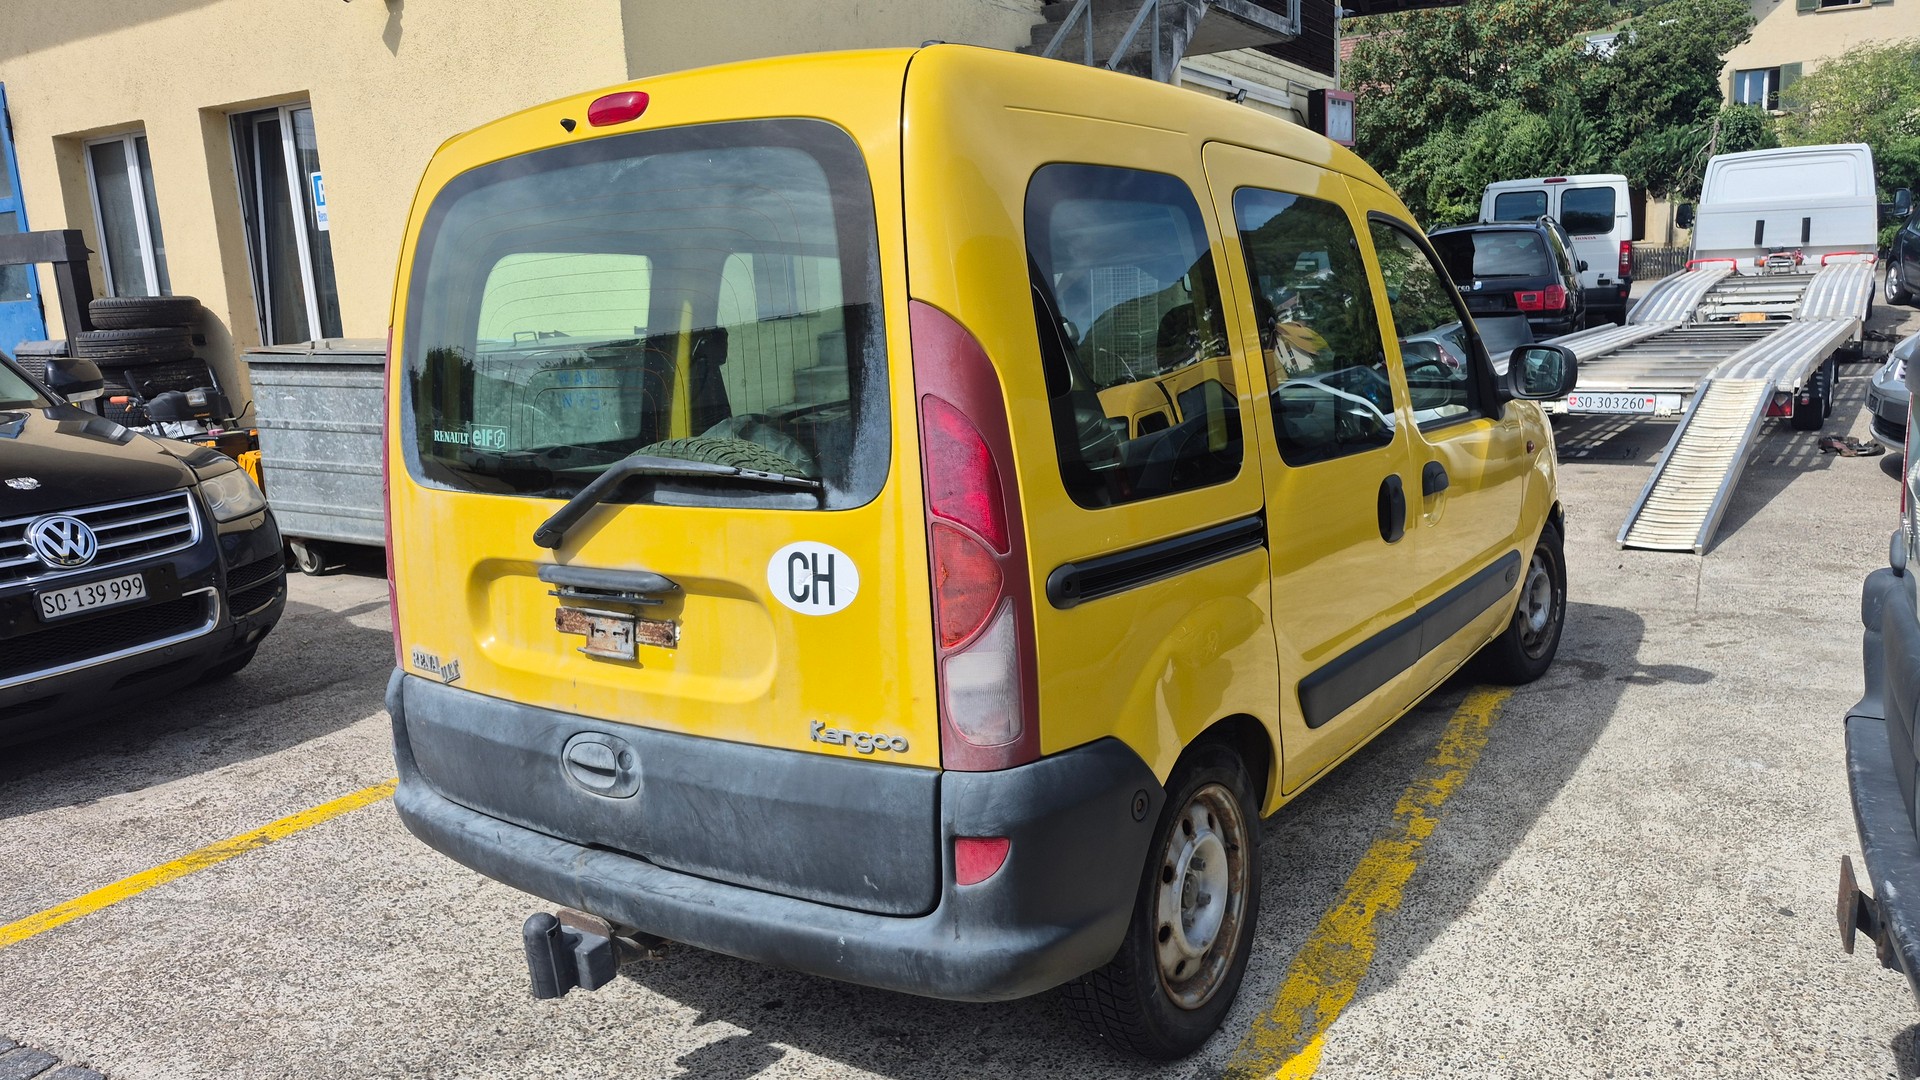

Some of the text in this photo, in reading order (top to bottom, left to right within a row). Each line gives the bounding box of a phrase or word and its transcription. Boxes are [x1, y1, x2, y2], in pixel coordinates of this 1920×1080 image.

[433, 428, 493, 447] RENAULT elf
[788, 551, 835, 606] CH
[810, 719, 909, 754] Kangoo
